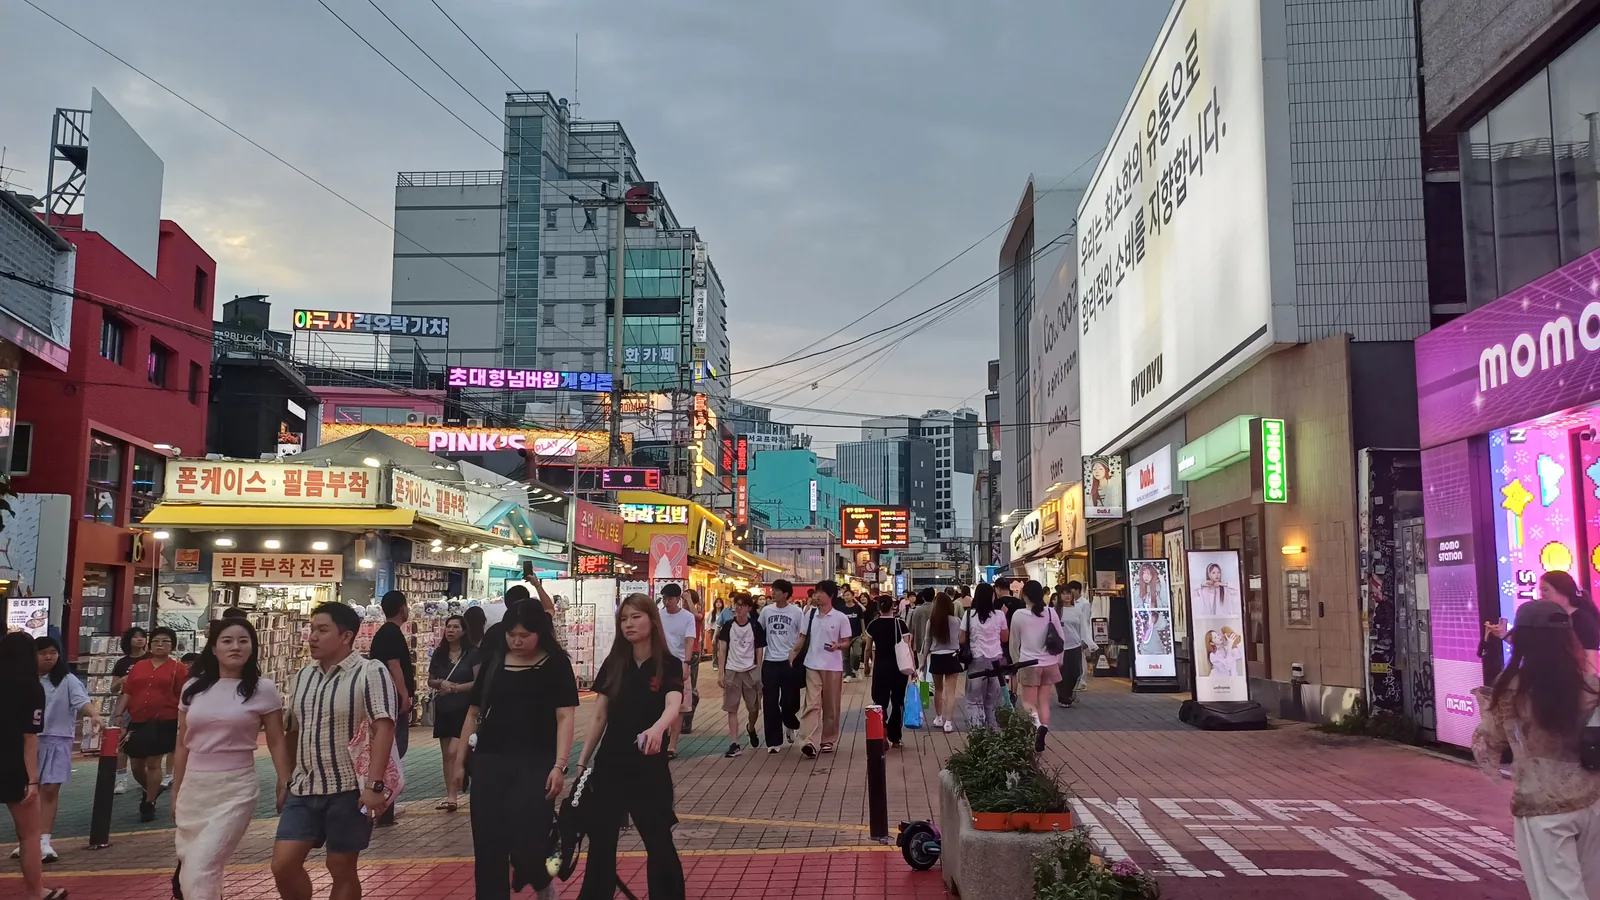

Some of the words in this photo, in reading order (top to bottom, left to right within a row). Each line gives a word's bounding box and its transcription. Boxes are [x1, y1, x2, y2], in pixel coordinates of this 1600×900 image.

[1081, 214, 1102, 276] 우리는
[1104, 130, 1143, 232] 최소한의
[1146, 28, 1200, 168] 유통으로
[1081, 254, 1113, 336] 합리적인
[1115, 206, 1146, 288] 소비를
[1149, 85, 1226, 236] 지향합니다.
[294, 310, 330, 329] 야구
[608, 347, 675, 363] 화카페
[428, 431, 526, 452] PINK'S
[1050, 457, 1064, 481] store
[176, 466, 267, 495] 폰케이스
[283, 468, 369, 498] 필름부착
[395, 475, 431, 508] 폰케이스
[435, 488, 465, 519] 필름부착
[220, 556, 296, 578] 필름부착
[299, 557, 336, 578] 전문
